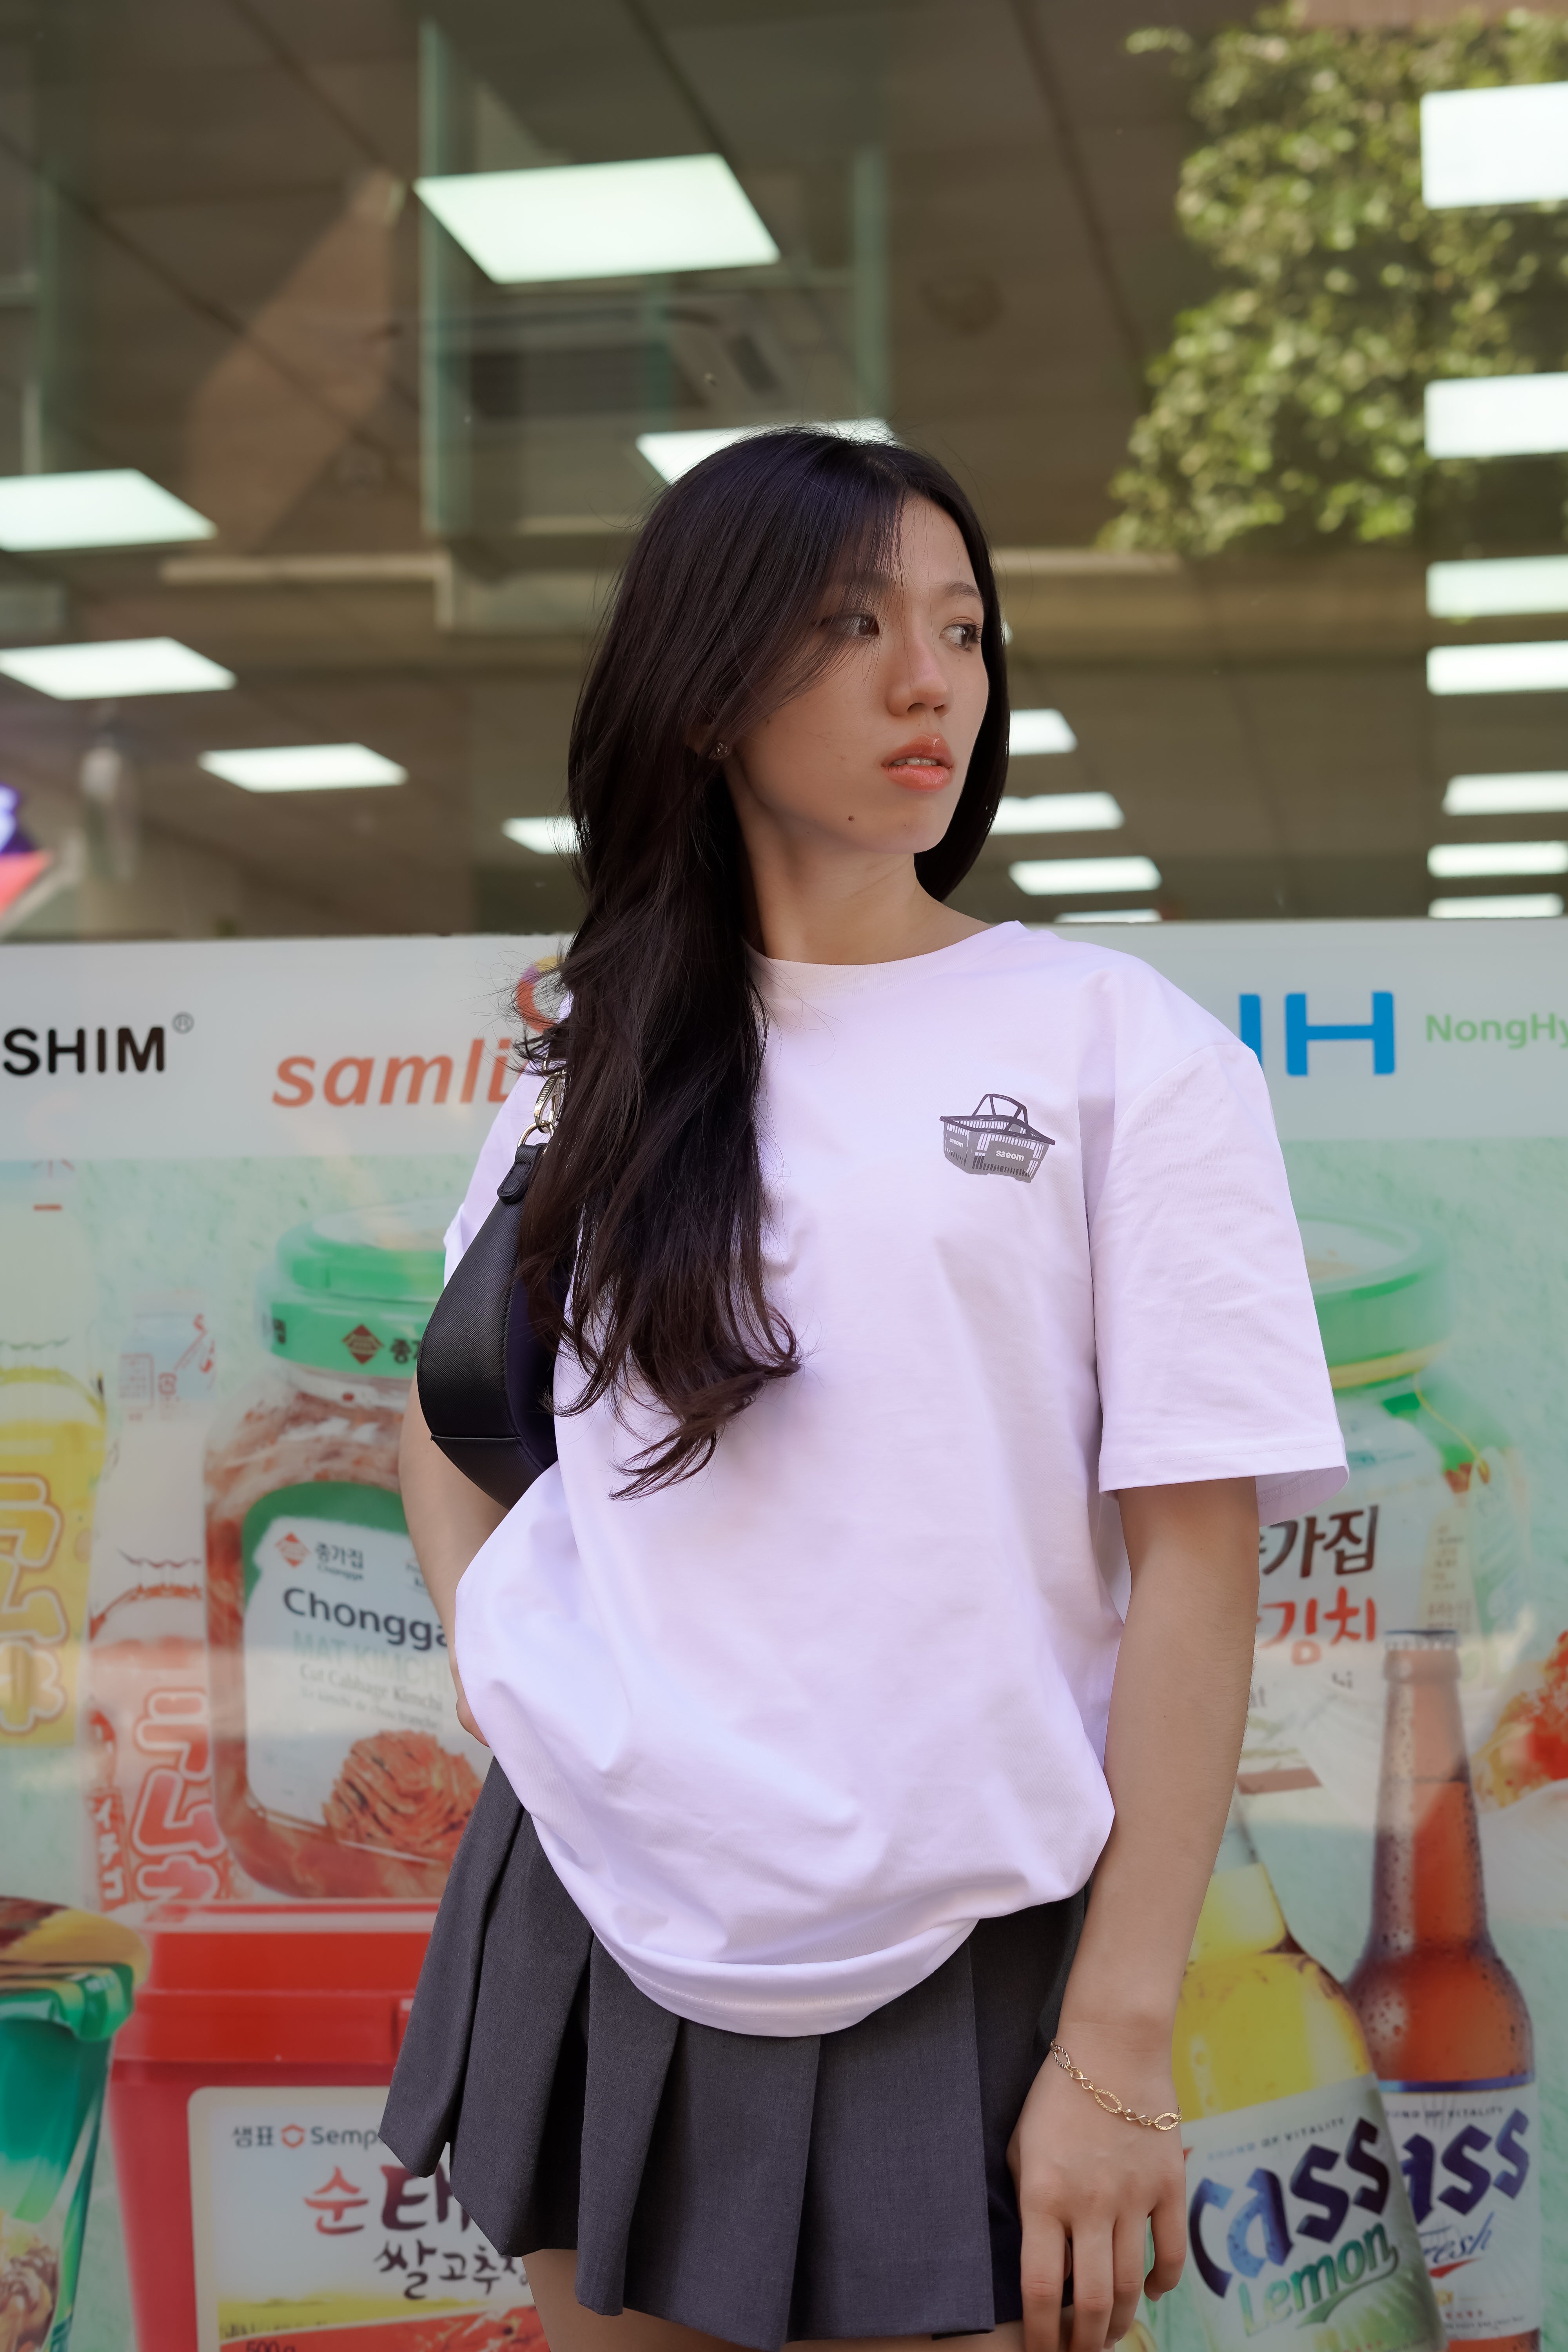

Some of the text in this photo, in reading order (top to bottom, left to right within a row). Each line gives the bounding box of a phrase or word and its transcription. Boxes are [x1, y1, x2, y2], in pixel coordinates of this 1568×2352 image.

[272, 1037, 528, 1108] samli
[1259, 1504, 1379, 1579] 가집
[1285, 2118, 1346, 2141] VITALITY
[1448, 2106, 1505, 2119] VITALITY
[233, 2125, 383, 2151] 샘표 Semp
[1238, 2221, 1399, 2338] Lemon
